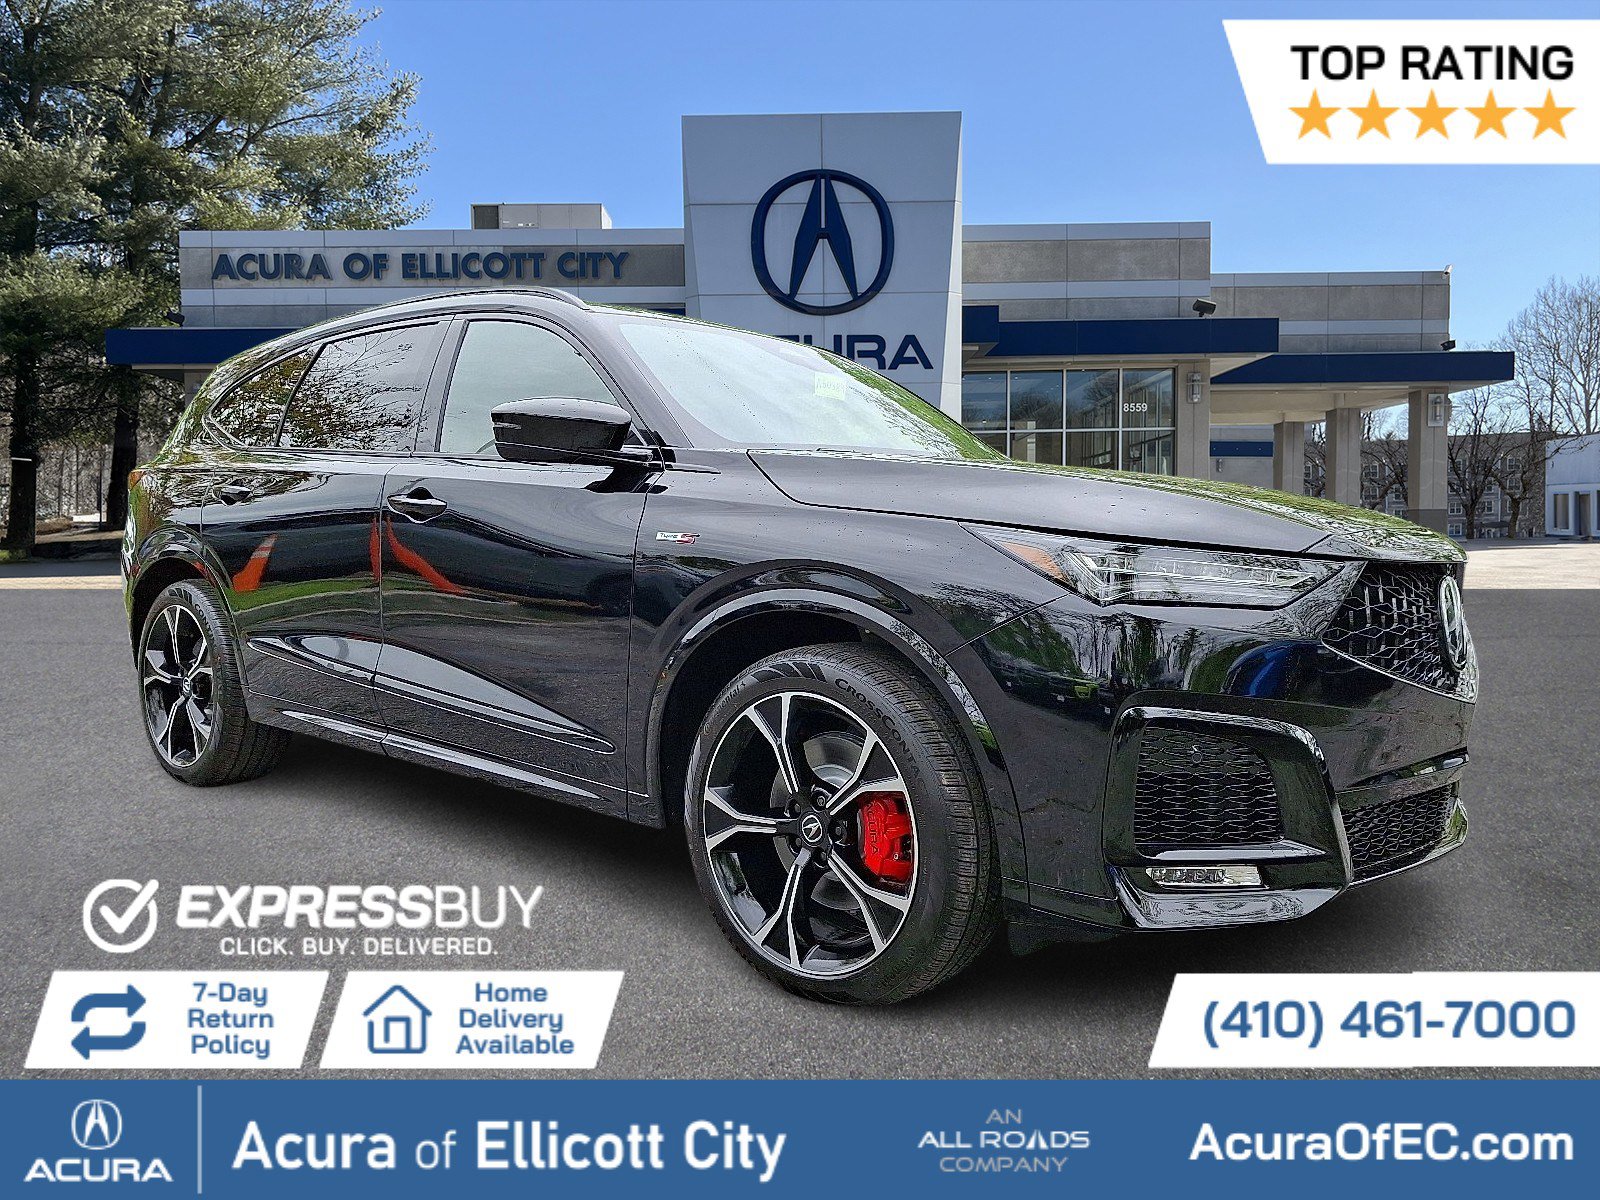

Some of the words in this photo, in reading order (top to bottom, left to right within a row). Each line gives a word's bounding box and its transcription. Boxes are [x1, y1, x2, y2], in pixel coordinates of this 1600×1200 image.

[211, 253, 331, 281] ACURA
[343, 252, 389, 281] OF
[401, 252, 546, 280] ELLICOTT
[556, 251, 629, 280] CITY
[1123, 402, 1148, 413] 8559
